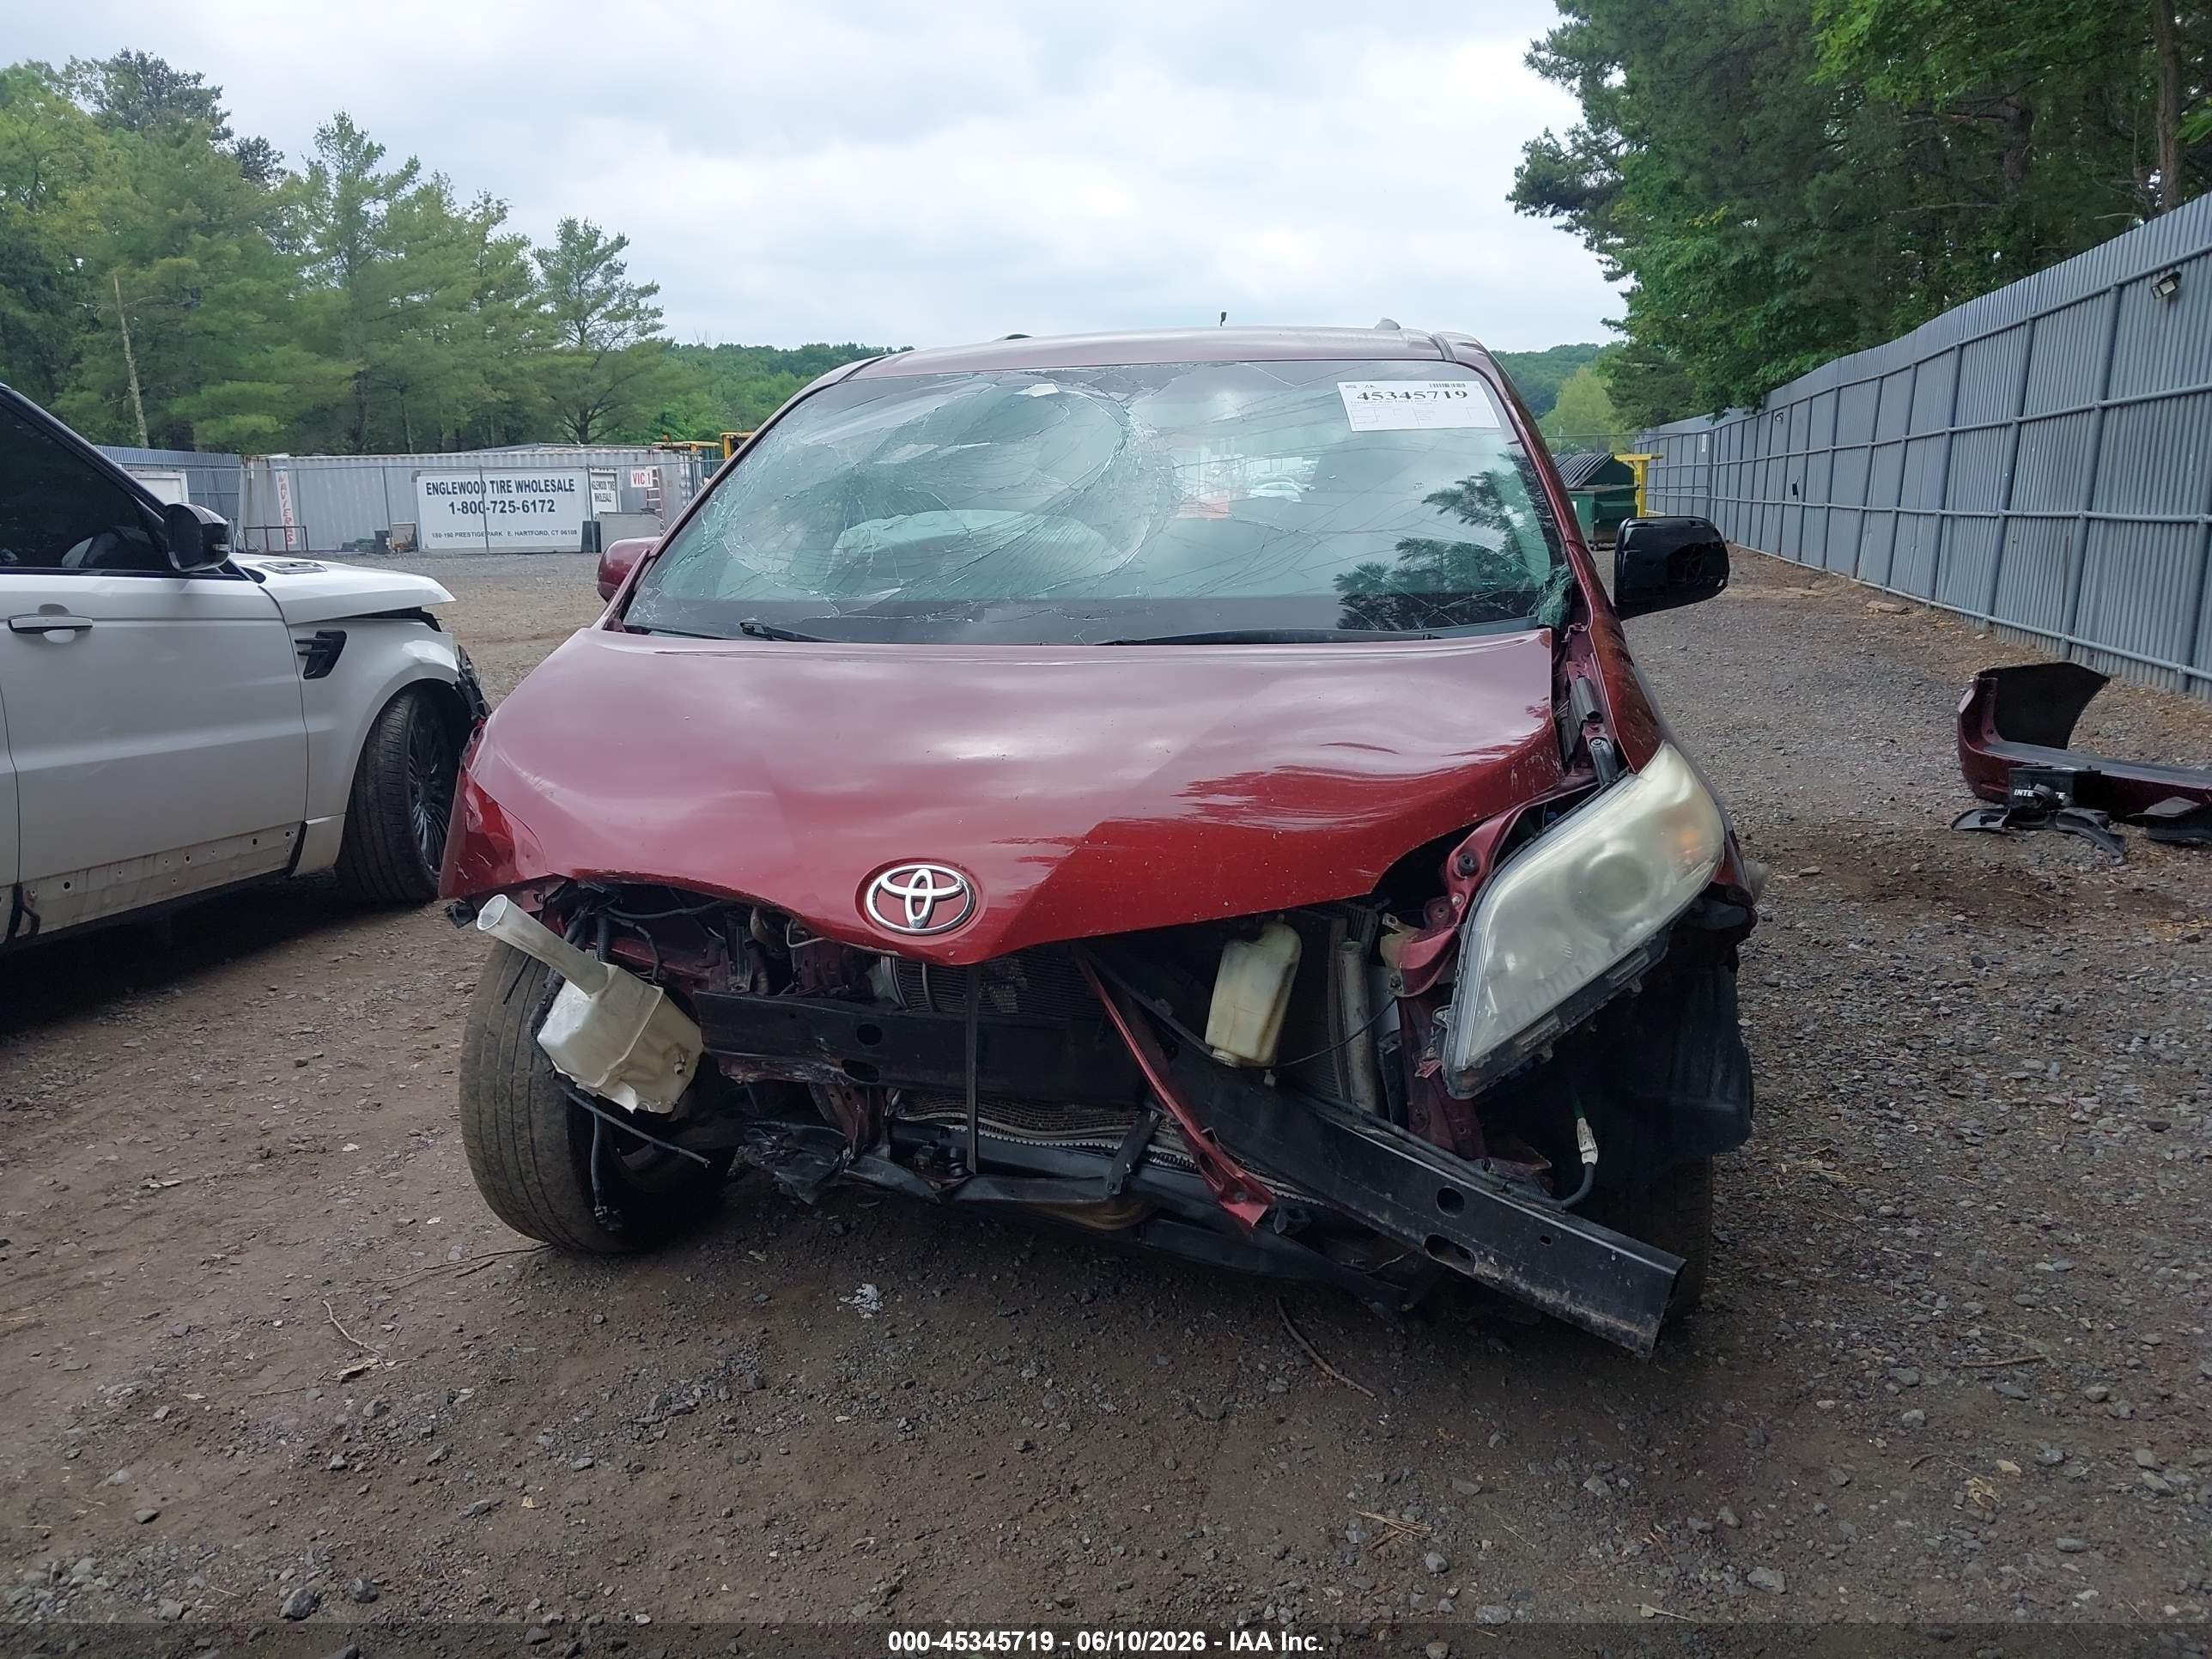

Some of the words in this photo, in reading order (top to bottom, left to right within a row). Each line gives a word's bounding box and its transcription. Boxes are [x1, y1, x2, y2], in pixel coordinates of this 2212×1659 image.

[1357, 390, 1468, 400] 45345719
[632, 472, 645, 485] VIC
[647, 471, 651, 485] 1
[426, 480, 487, 495] ENGLEWOOD
[489, 480, 513, 494] TIRE
[515, 478, 575, 493] WHOLESALE
[448, 499, 556, 515] 1-800-725-6172
